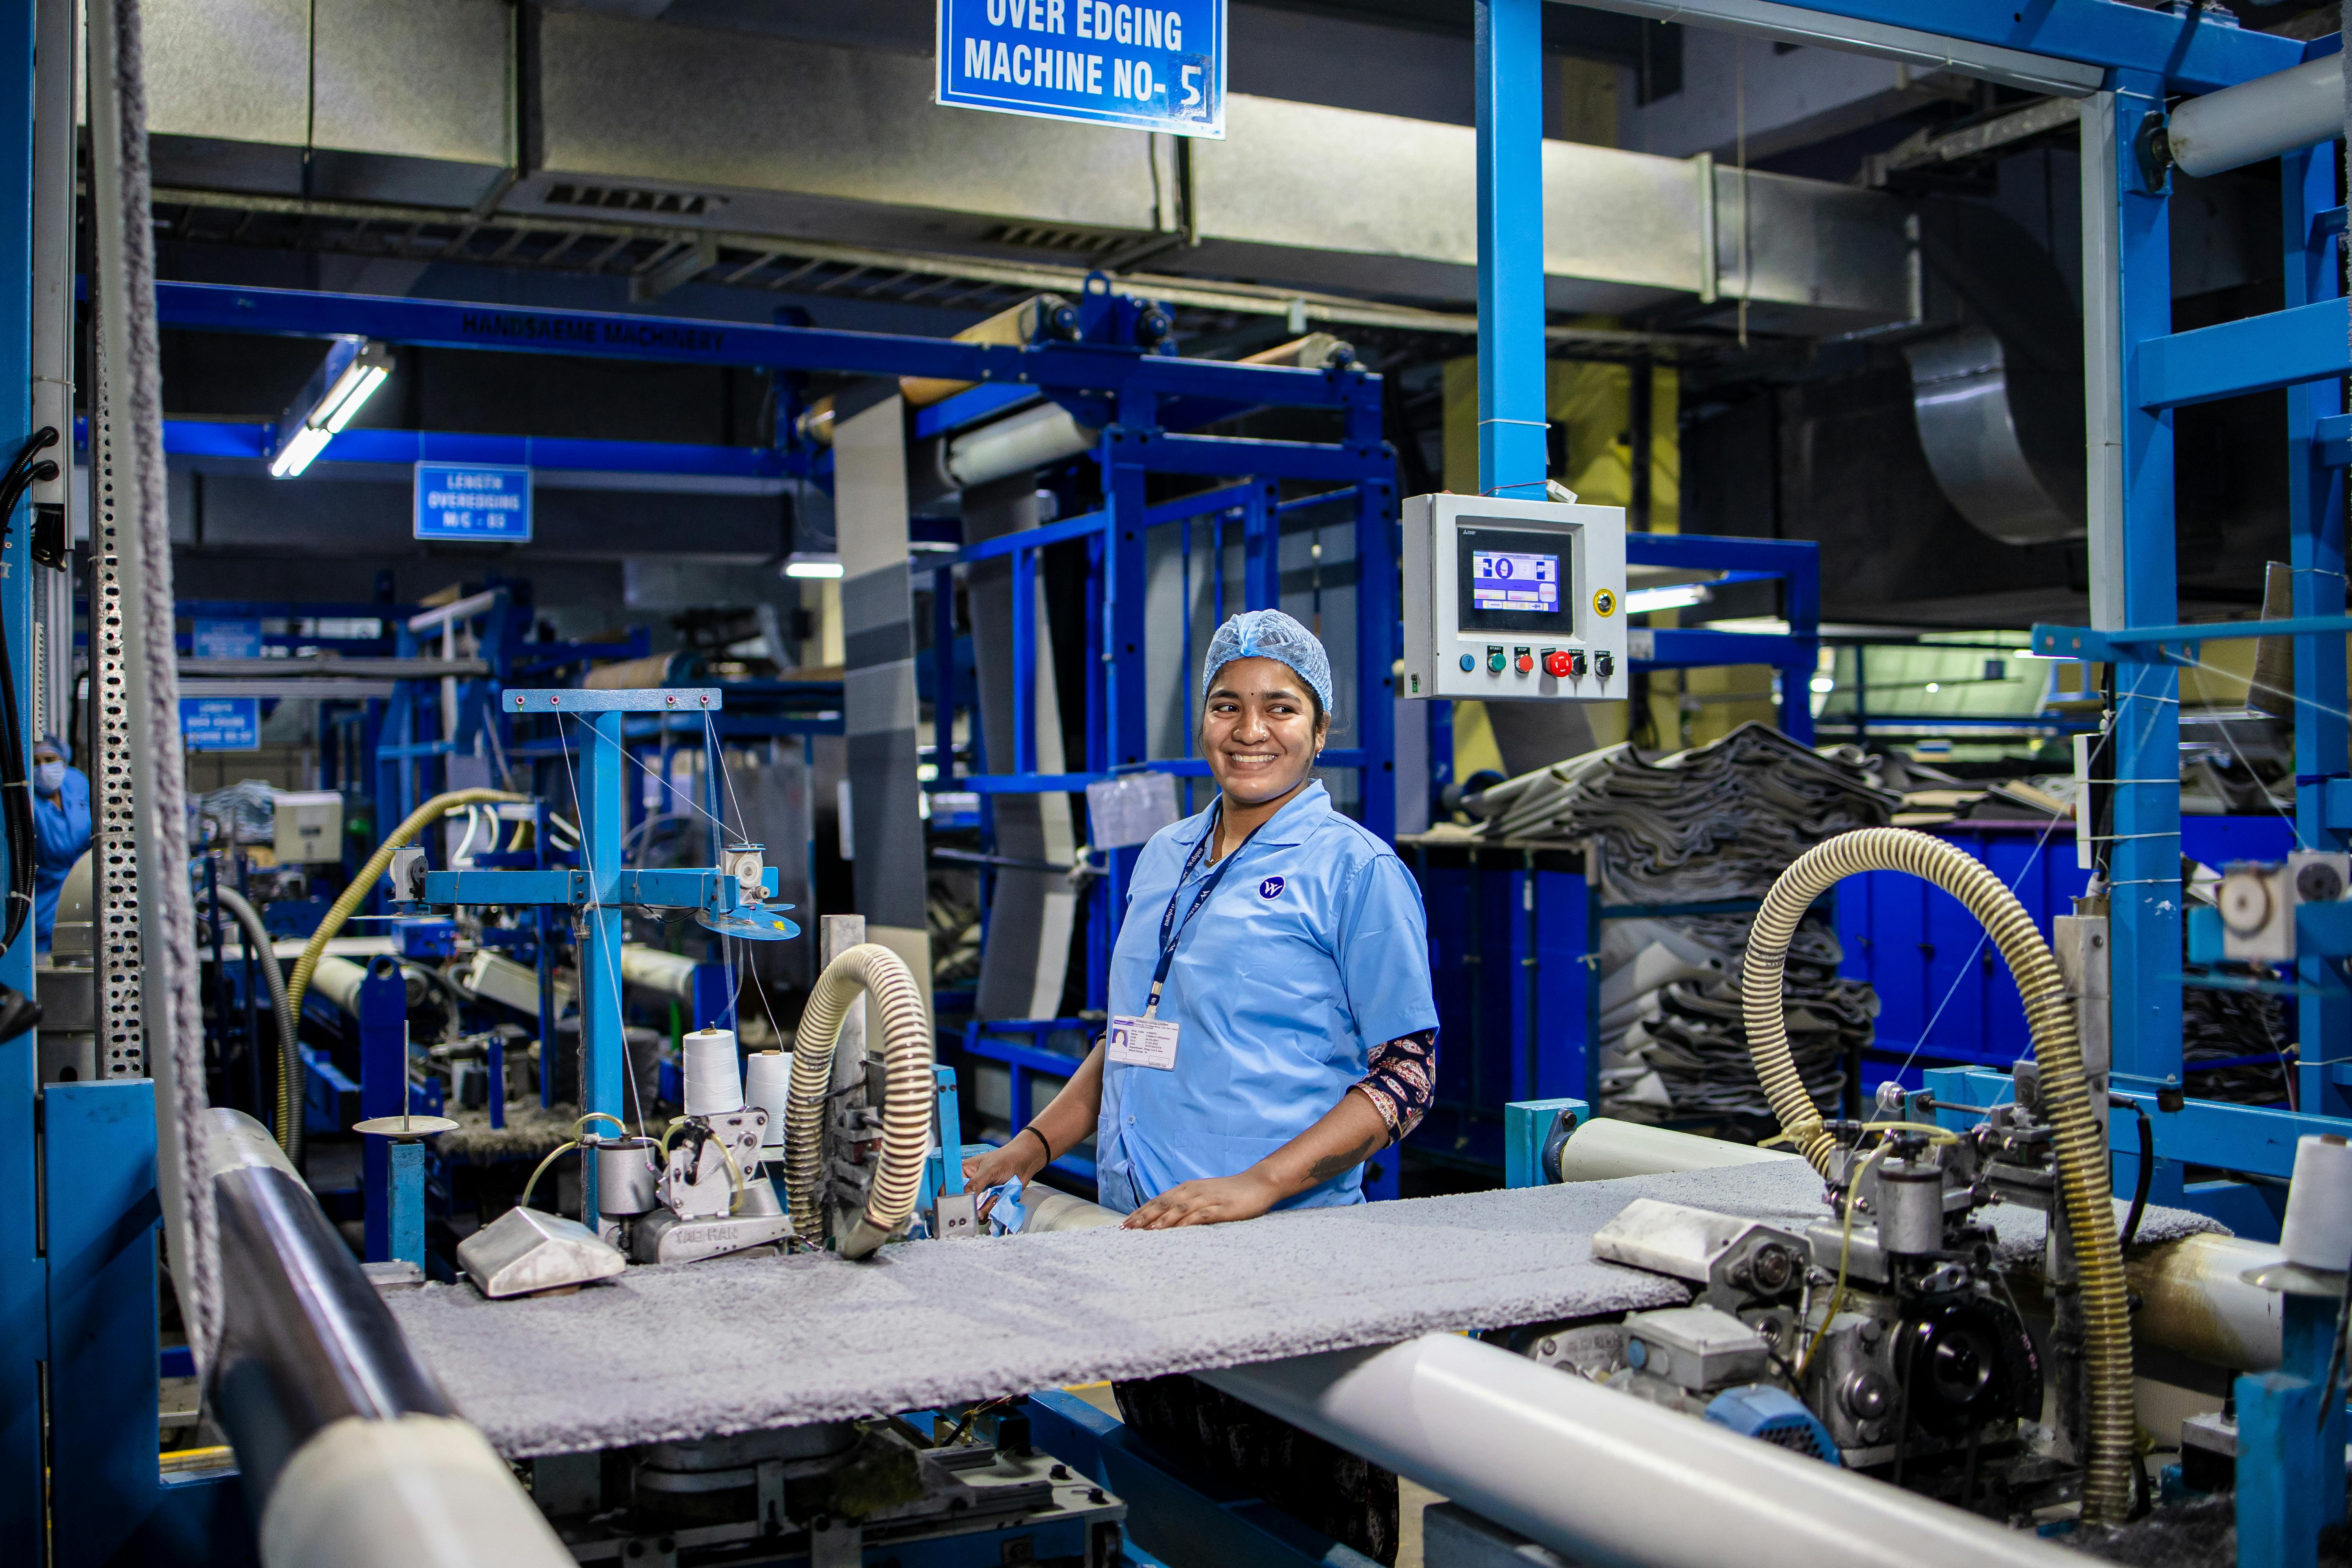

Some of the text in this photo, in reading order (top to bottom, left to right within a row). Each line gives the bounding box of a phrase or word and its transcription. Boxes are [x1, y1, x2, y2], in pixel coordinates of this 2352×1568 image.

[987, 0, 1181, 51] OVER EDGING
[964, 37, 1103, 95] MACHINE
[1114, 58, 1166, 102] NO-
[462, 313, 724, 351] HANDSAEME MACHINERY
[1187, 847, 1203, 866] Welspun
[1164, 904, 1175, 927] Welspun
[674, 1226, 739, 1244] YAO HAN
